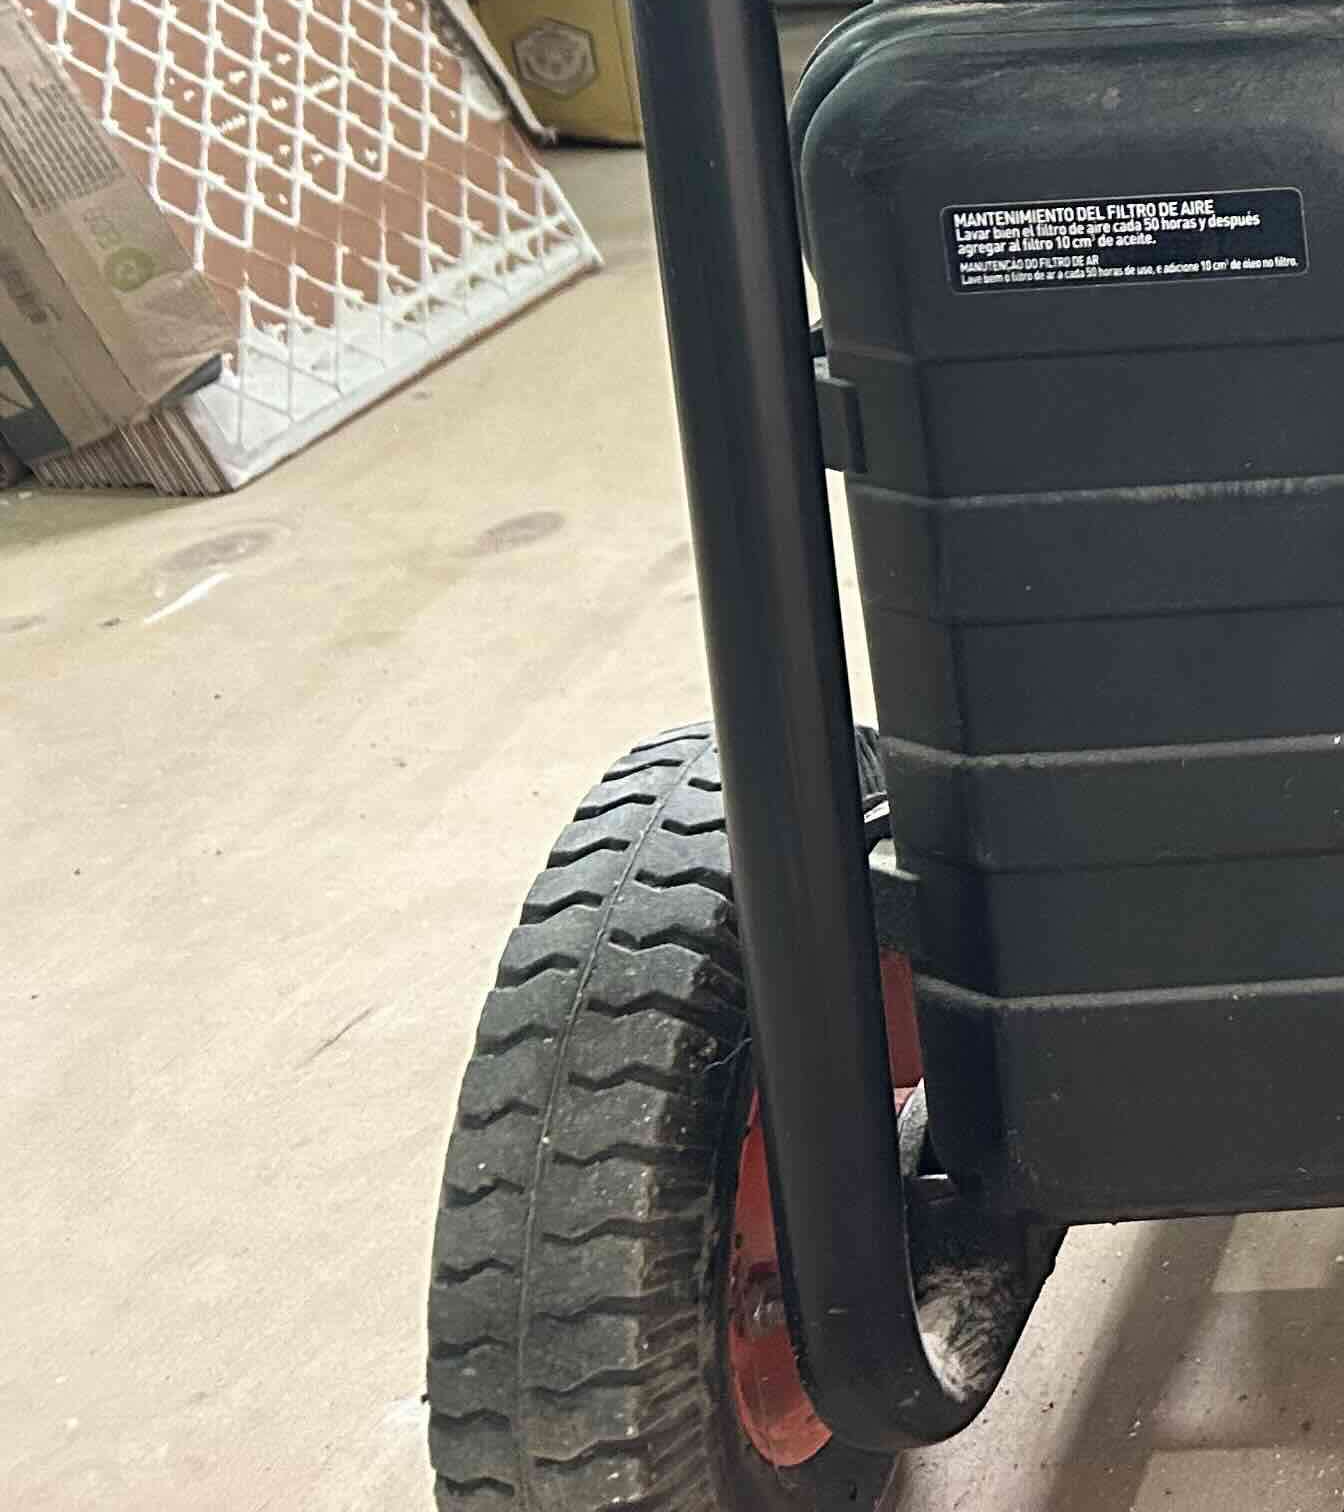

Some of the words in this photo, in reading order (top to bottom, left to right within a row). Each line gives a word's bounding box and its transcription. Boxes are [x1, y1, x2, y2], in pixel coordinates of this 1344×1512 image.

[953, 207, 1074, 228] MANTENIMIENTO
[1076, 206, 1105, 222] DEL
[1107, 203, 1156, 220] FILTRO
[1158, 201, 1178, 217] DE
[1180, 199, 1215, 216] AIRE
[955, 228, 991, 241] Lavar
[993, 227, 1021, 240] bien
[1022, 226, 1034, 238] el
[1036, 224, 1067, 237] filtro
[1068, 223, 1085, 235] de
[1086, 222, 1111, 234] aire
[1113, 219, 1142, 233] cada
[1143, 217, 1160, 231] 50
[1161, 216, 1198, 231] horas
[1198, 218, 1207, 232] y
[1208, 211, 1261, 230] después
[957, 243, 1007, 257] agregar
[1008, 240, 1021, 252] al
[1022, 238, 1054, 251] filtro
[1056, 236, 1070, 249] 10
[1098, 234, 1114, 247] de
[1115, 233, 1157, 246] aceite.
[1025, 259, 1038, 270] DO
[1039, 257, 1071, 269] FILTRO
[1072, 256, 1085, 266] DE
[1086, 255, 1100, 265] AR
[1034, 270, 1045, 280] de
[1124, 265, 1136, 275] de
